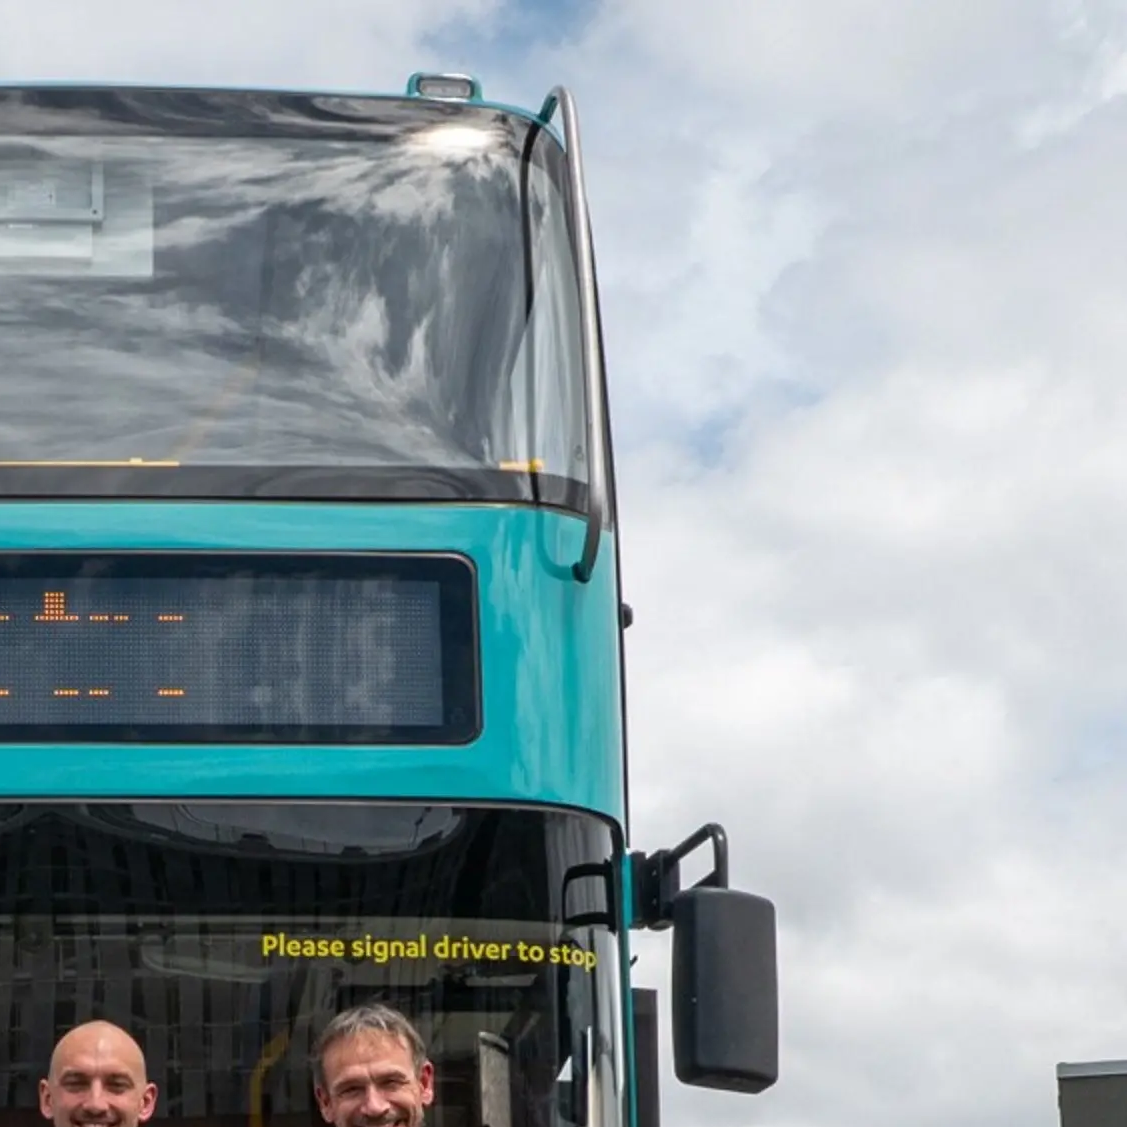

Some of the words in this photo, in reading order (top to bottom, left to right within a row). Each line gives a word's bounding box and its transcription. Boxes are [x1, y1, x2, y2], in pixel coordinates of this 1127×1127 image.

[262, 933, 345, 958] Please
[351, 934, 426, 963] signal
[434, 935, 511, 960] driver
[517, 940, 544, 963] to
[549, 944, 597, 972] stop
